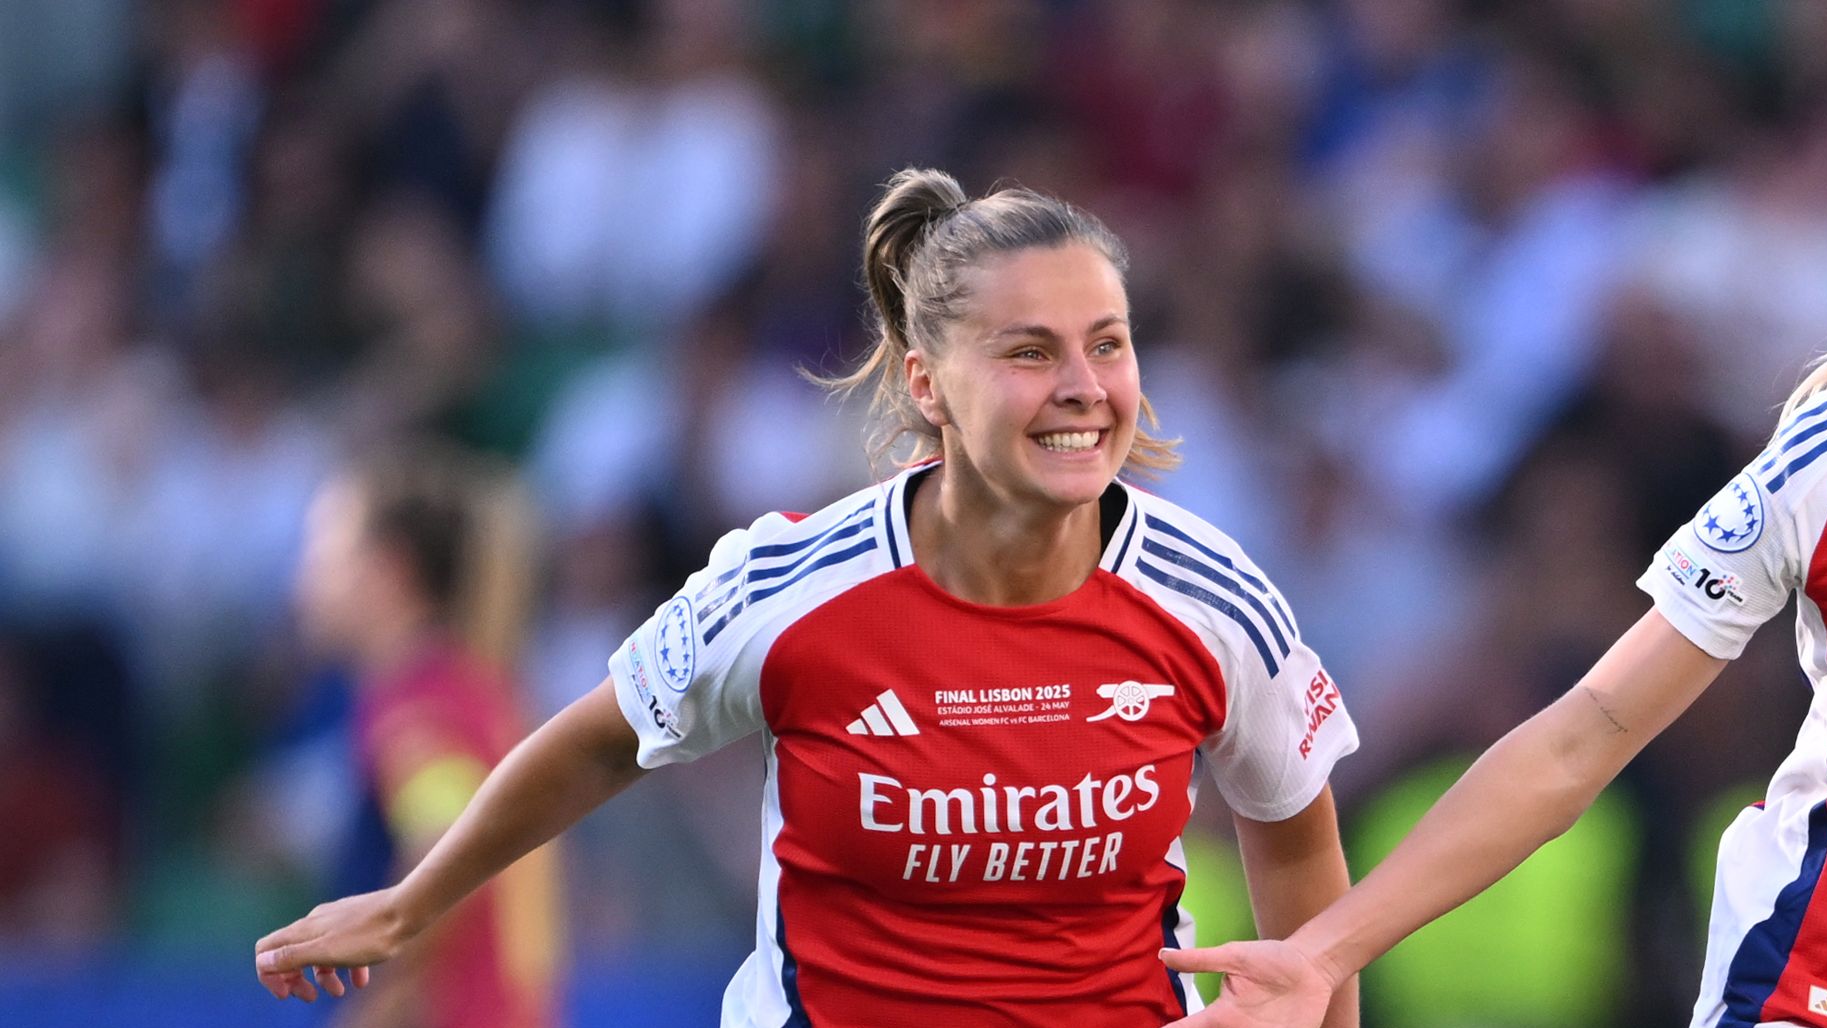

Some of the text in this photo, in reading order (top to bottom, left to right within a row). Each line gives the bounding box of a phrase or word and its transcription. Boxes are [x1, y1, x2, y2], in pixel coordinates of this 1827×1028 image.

[935, 684, 1071, 704] FINAL LISBON 2025
[937, 705, 972, 715] ESTÁDIO
[973, 704, 992, 714] JOSÉ
[993, 703, 1034, 713] ALVALADE
[1052, 701, 1070, 710] MAY
[939, 719, 971, 727] ARSENAL
[1000, 717, 1009, 725] FC
[1018, 715, 1027, 724] FC
[1027, 713, 1070, 724] BARCELONA
[857, 763, 1160, 835] Emirates
[902, 831, 1123, 883] FLY BETTER
